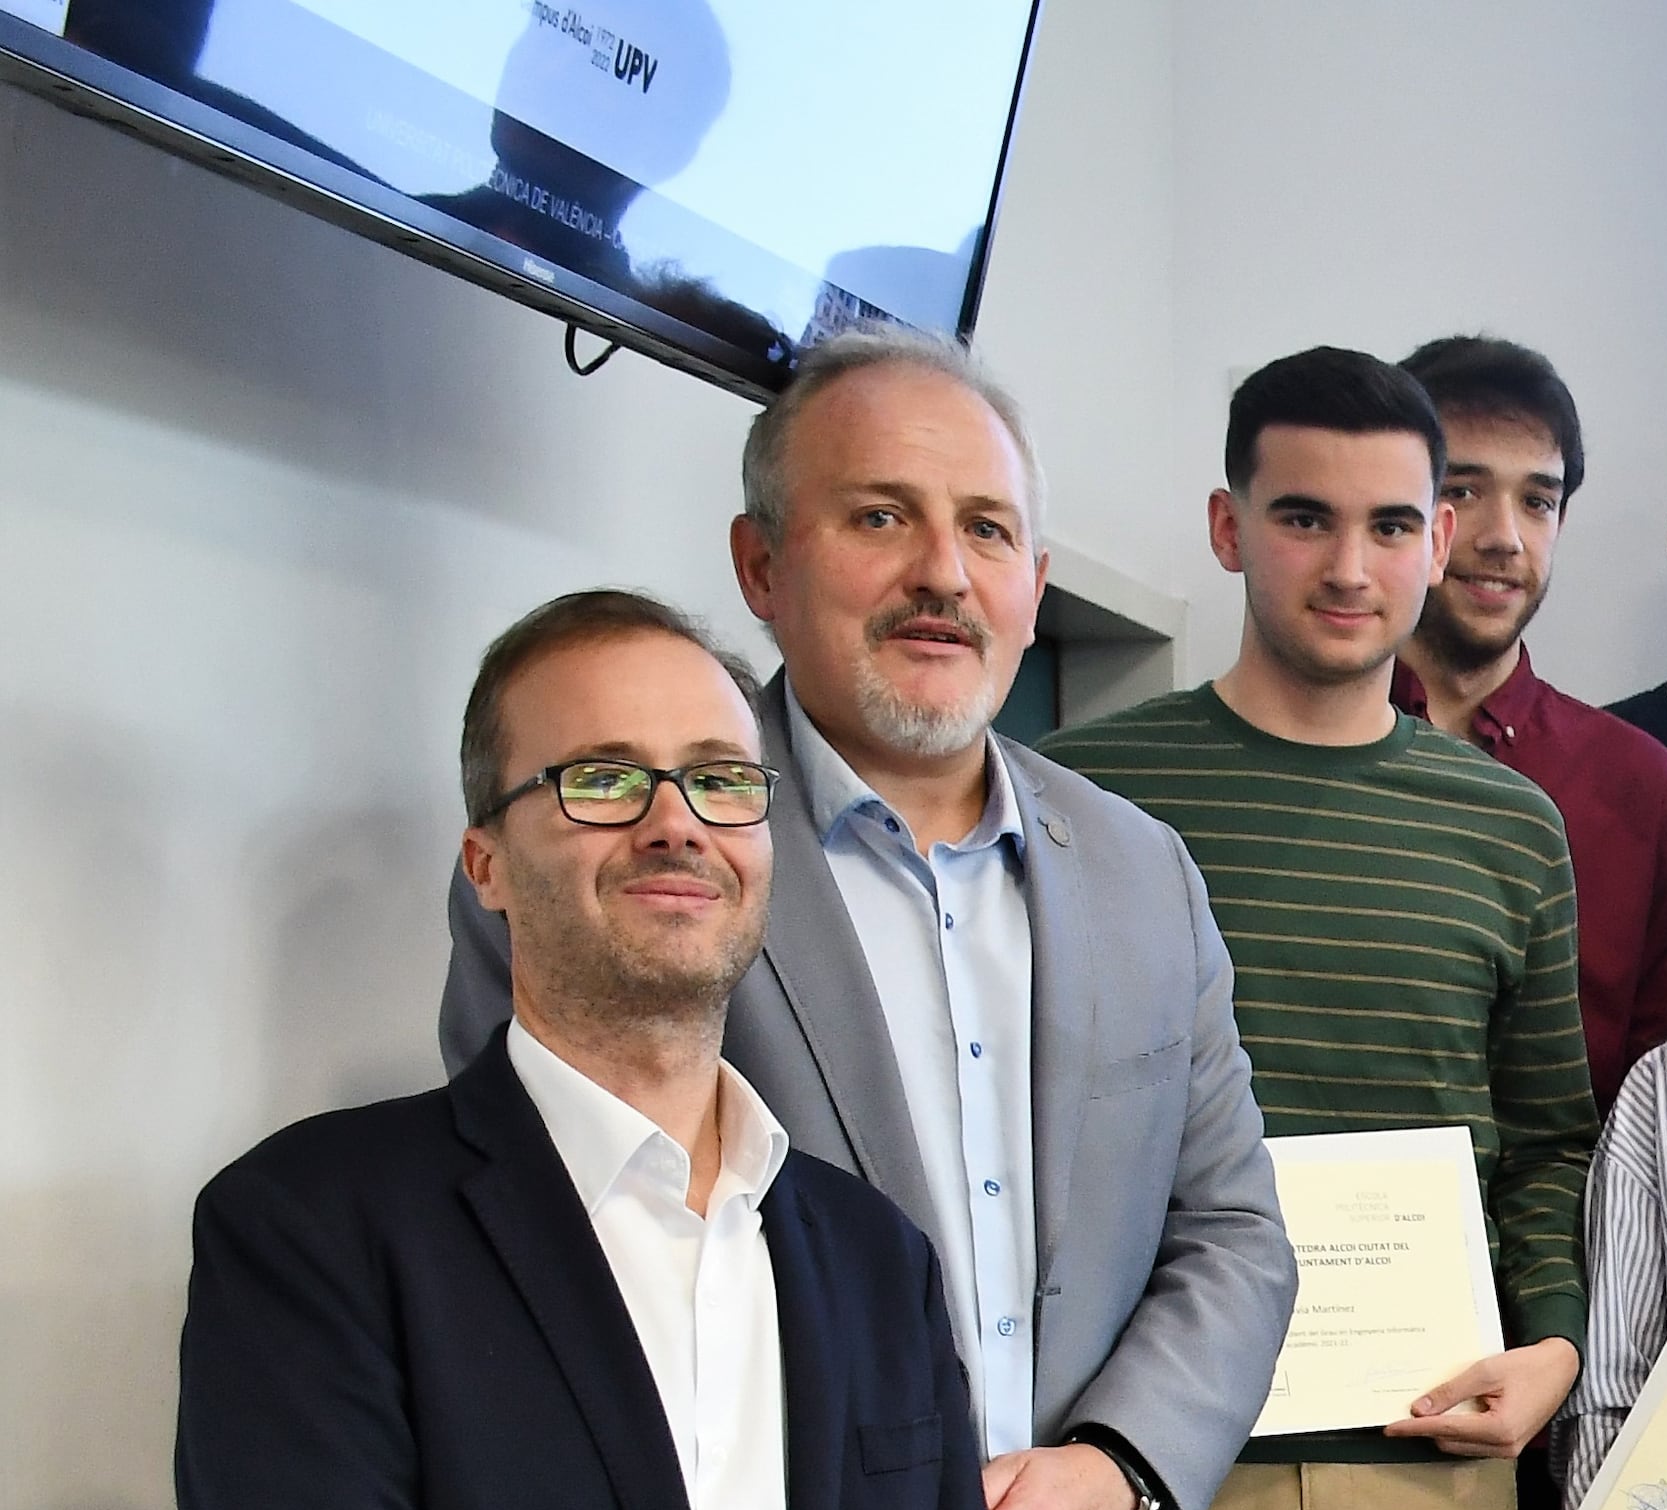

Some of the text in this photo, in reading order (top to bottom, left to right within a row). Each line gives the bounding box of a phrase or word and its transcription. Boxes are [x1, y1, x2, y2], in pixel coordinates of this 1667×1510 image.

[614, 39, 658, 94] UPV
[532, 186, 548, 214] DE
[1394, 1214, 1426, 1223] D'ALCOI
[1329, 1243, 1356, 1252] ALCOI
[1358, 1242, 1391, 1251] CIUTAT
[1393, 1242, 1410, 1251] DEL
[1355, 1256, 1391, 1266] D'ALCOI
